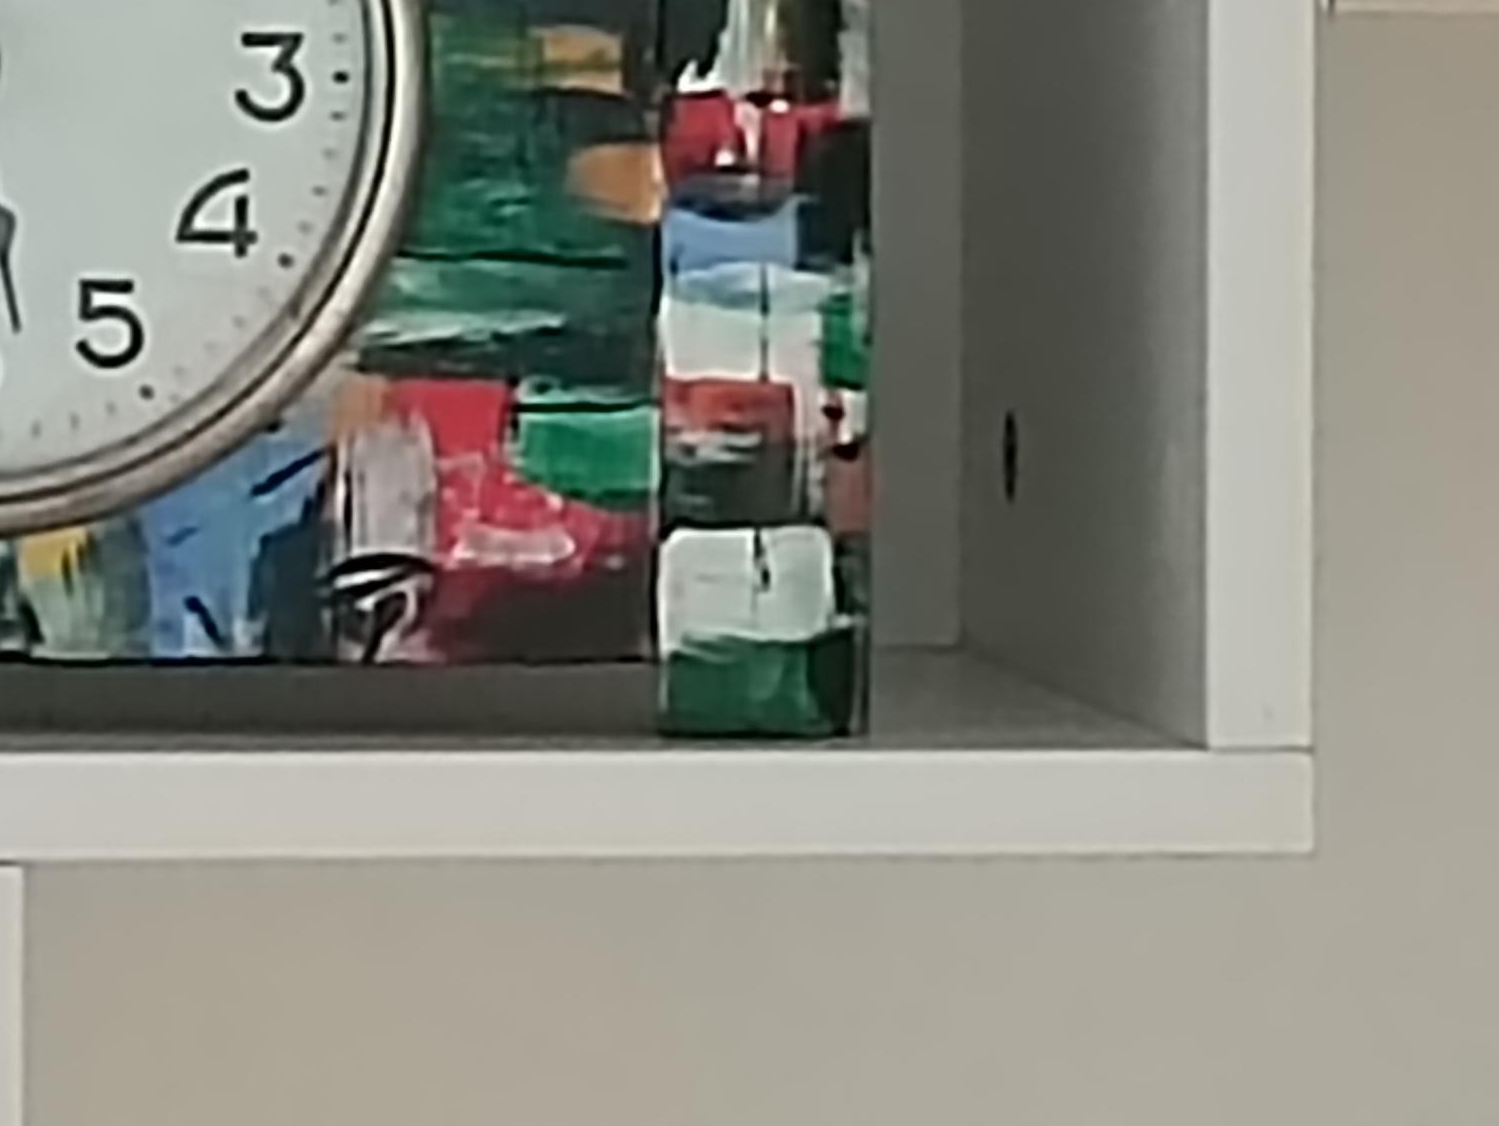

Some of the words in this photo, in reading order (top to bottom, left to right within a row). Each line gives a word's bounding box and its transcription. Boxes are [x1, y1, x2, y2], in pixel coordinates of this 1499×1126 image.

[234, 31, 306, 123] 3
[175, 168, 259, 260] 4
[75, 278, 146, 370] 5
